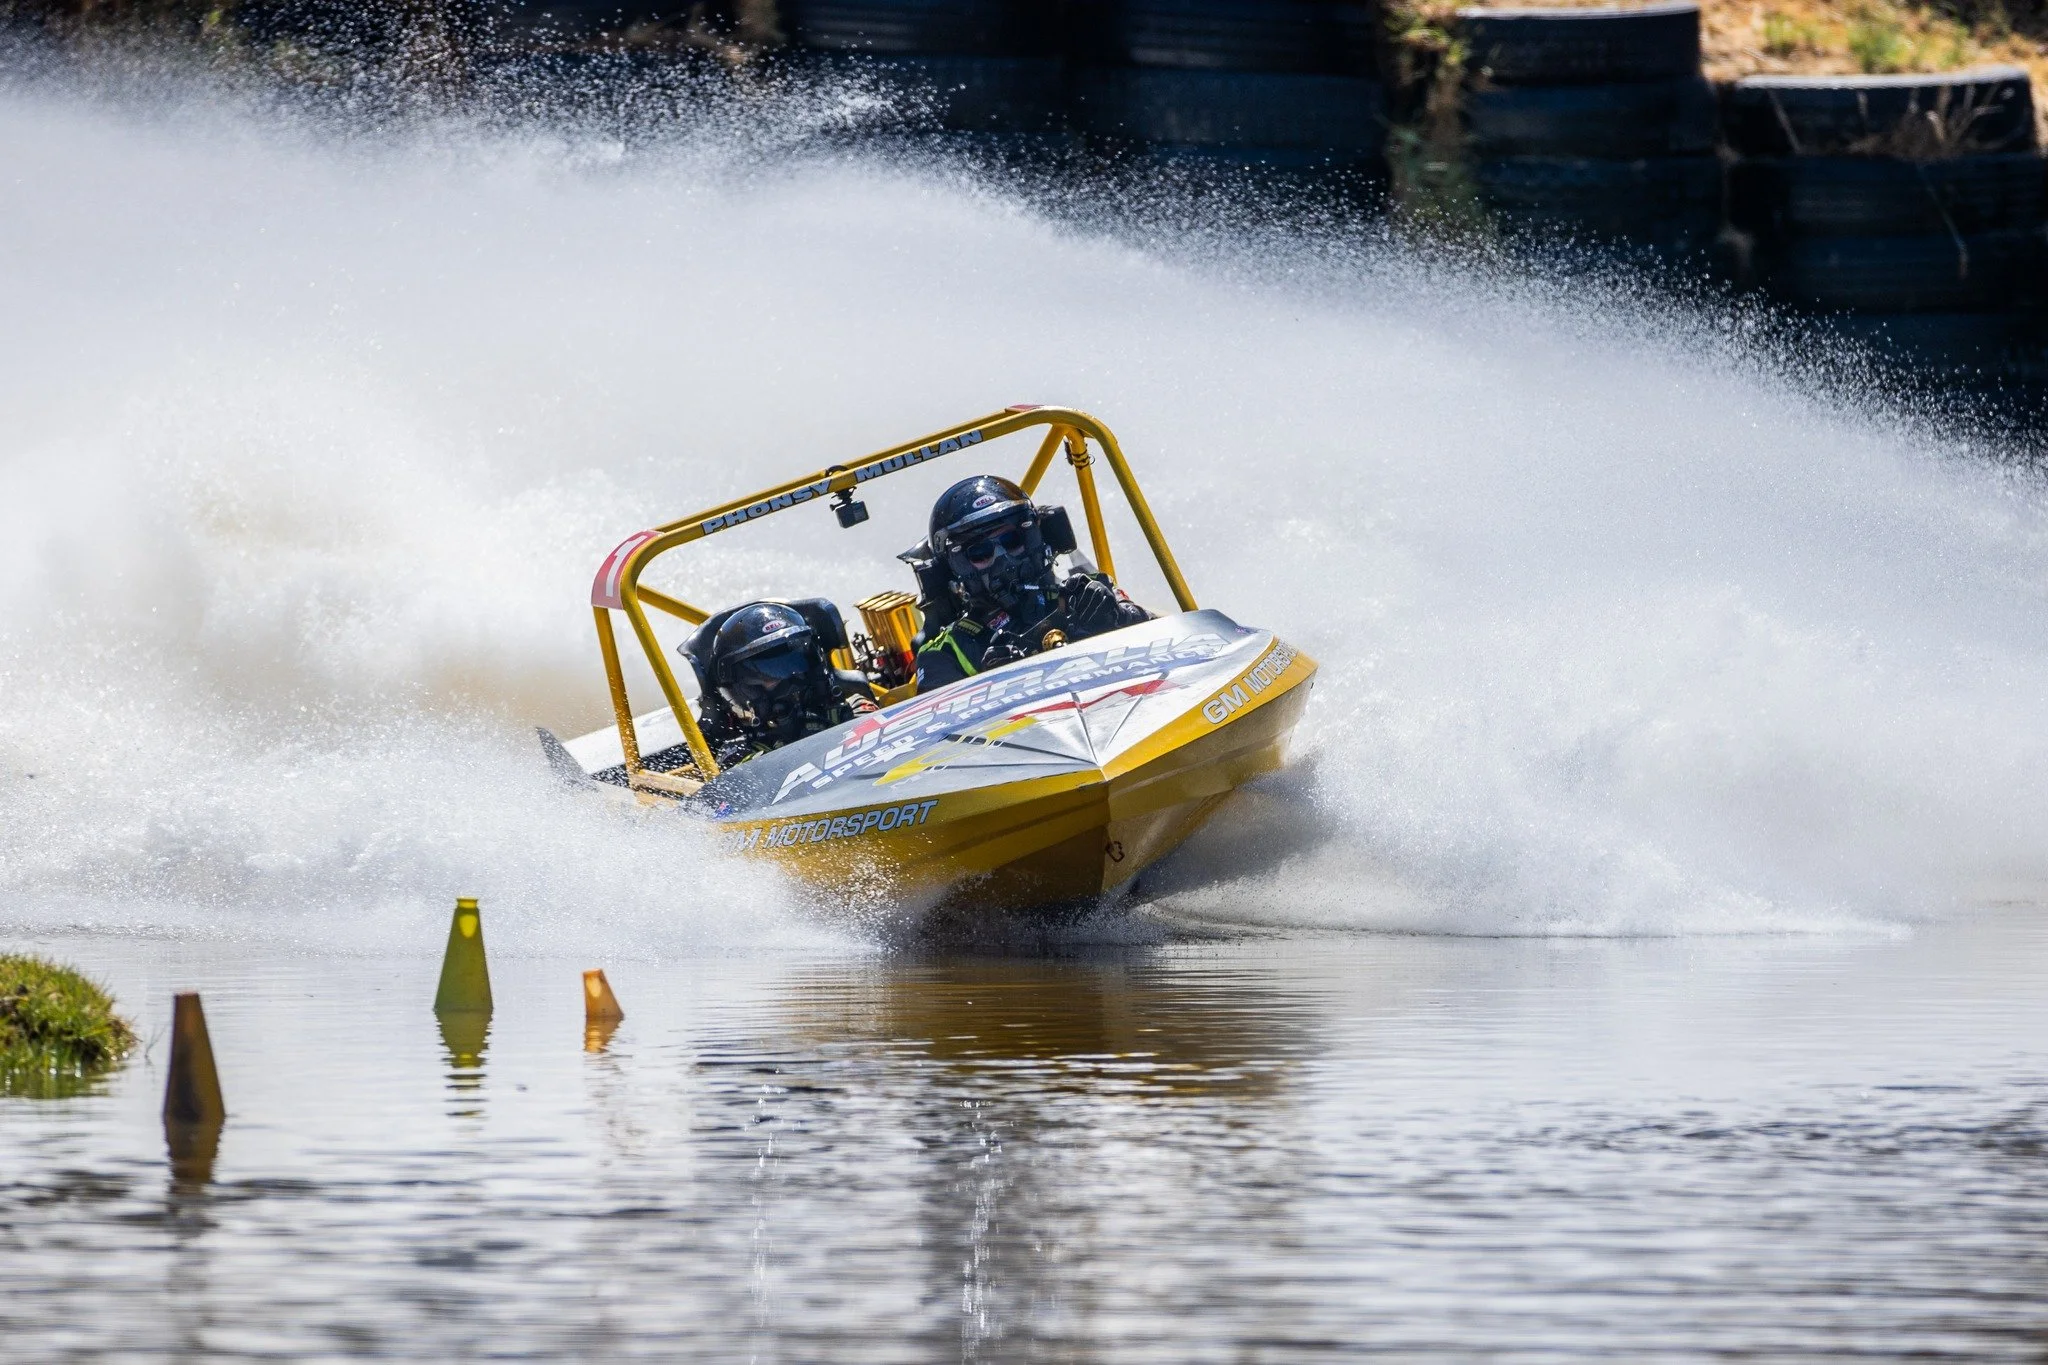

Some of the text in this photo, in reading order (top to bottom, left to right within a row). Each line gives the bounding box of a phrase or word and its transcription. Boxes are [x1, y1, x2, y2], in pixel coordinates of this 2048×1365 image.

[702, 430, 983, 535] PHONSY MULLAN
[771, 633, 1231, 805] AUSTRALIA
[1202, 682, 1251, 724] GM
[812, 735, 914, 789] SPEED
[925, 721, 950, 734] &
[763, 800, 939, 850] MOTORSPORT
